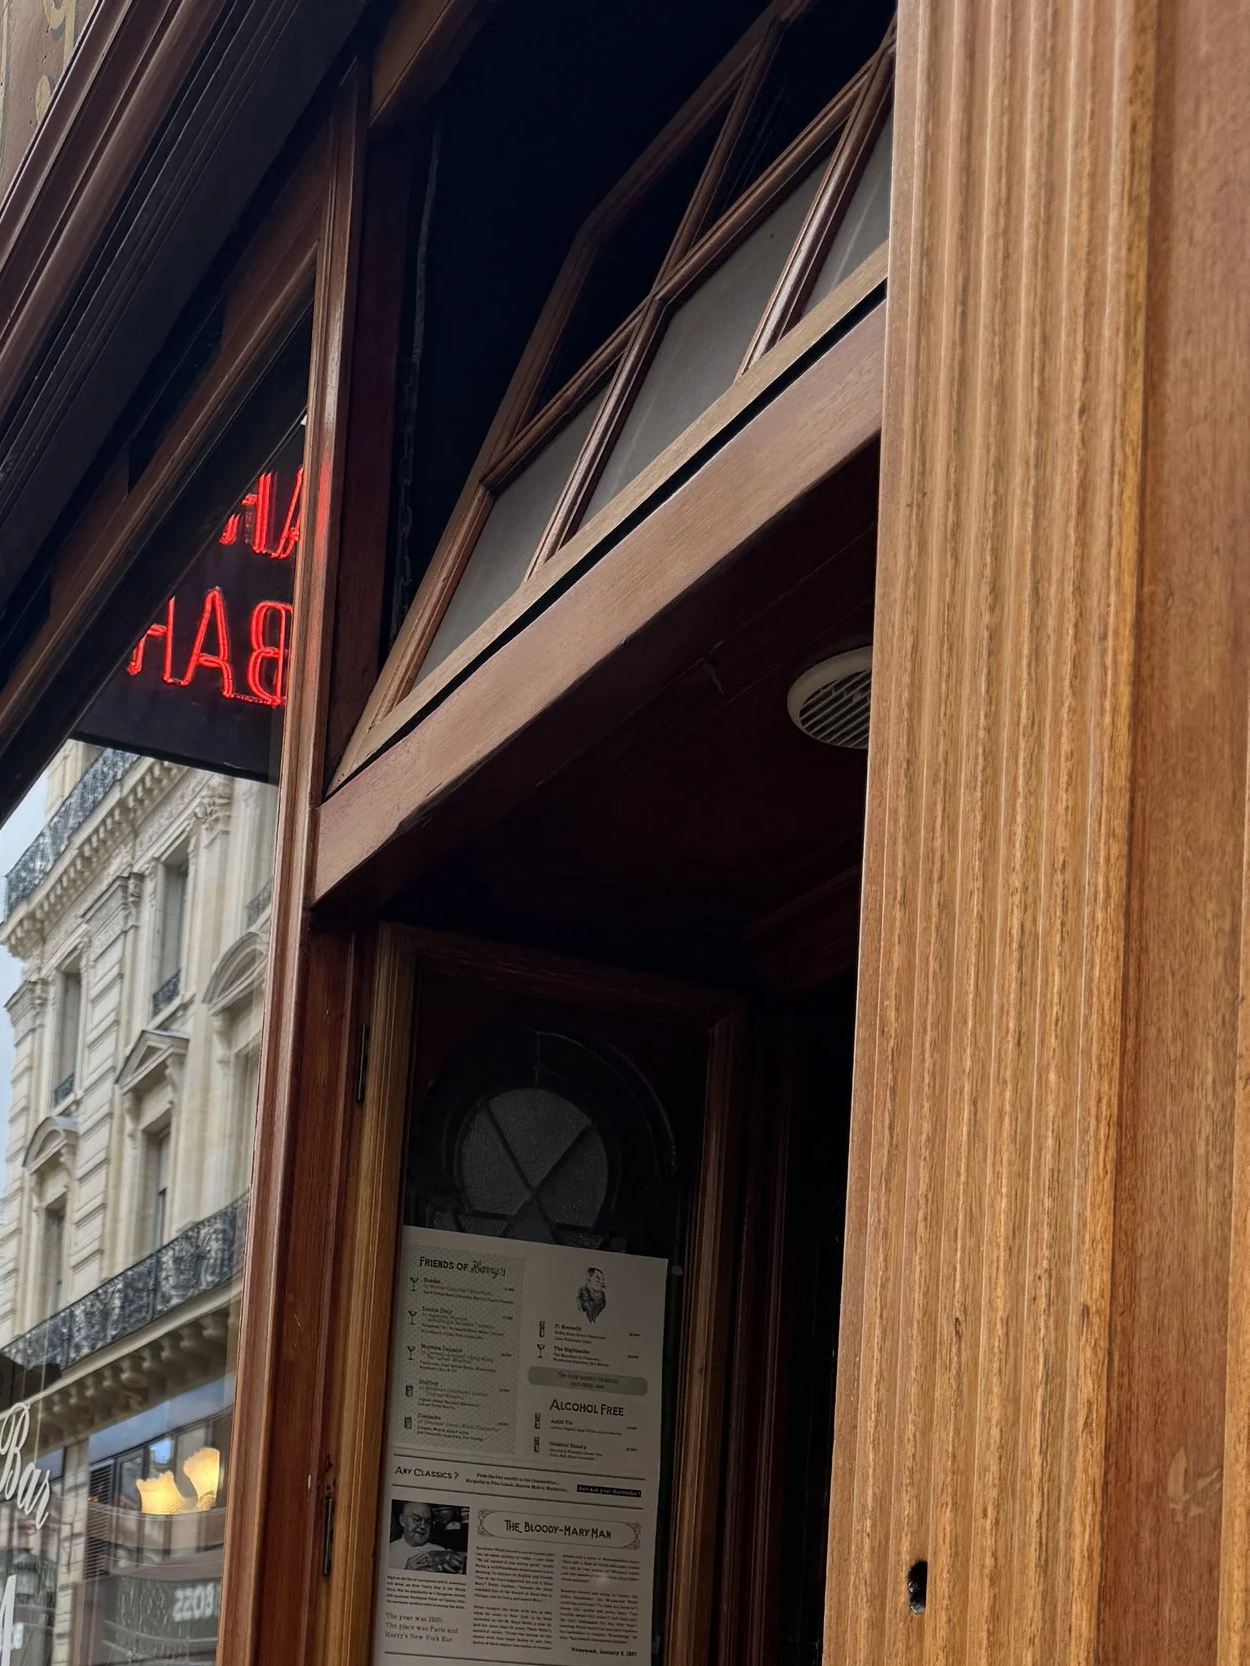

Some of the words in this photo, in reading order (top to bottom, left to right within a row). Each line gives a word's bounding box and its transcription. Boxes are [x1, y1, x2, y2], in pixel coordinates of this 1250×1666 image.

[419, 1256, 455, 1270] FRIENDS
[456, 1262, 469, 1272] OF
[470, 1259, 507, 1279] Harry's
[550, 1399, 599, 1415] ALCOHOL
[601, 1404, 625, 1417] FREE
[394, 1466, 412, 1476] ANY
[414, 1468, 453, 1480] CLASSICS
[454, 1471, 459, 1480] ?
[504, 1519, 522, 1534] THE
[524, 1521, 590, 1537] BLOODY-MARY
[591, 1527, 612, 1540] MAN
